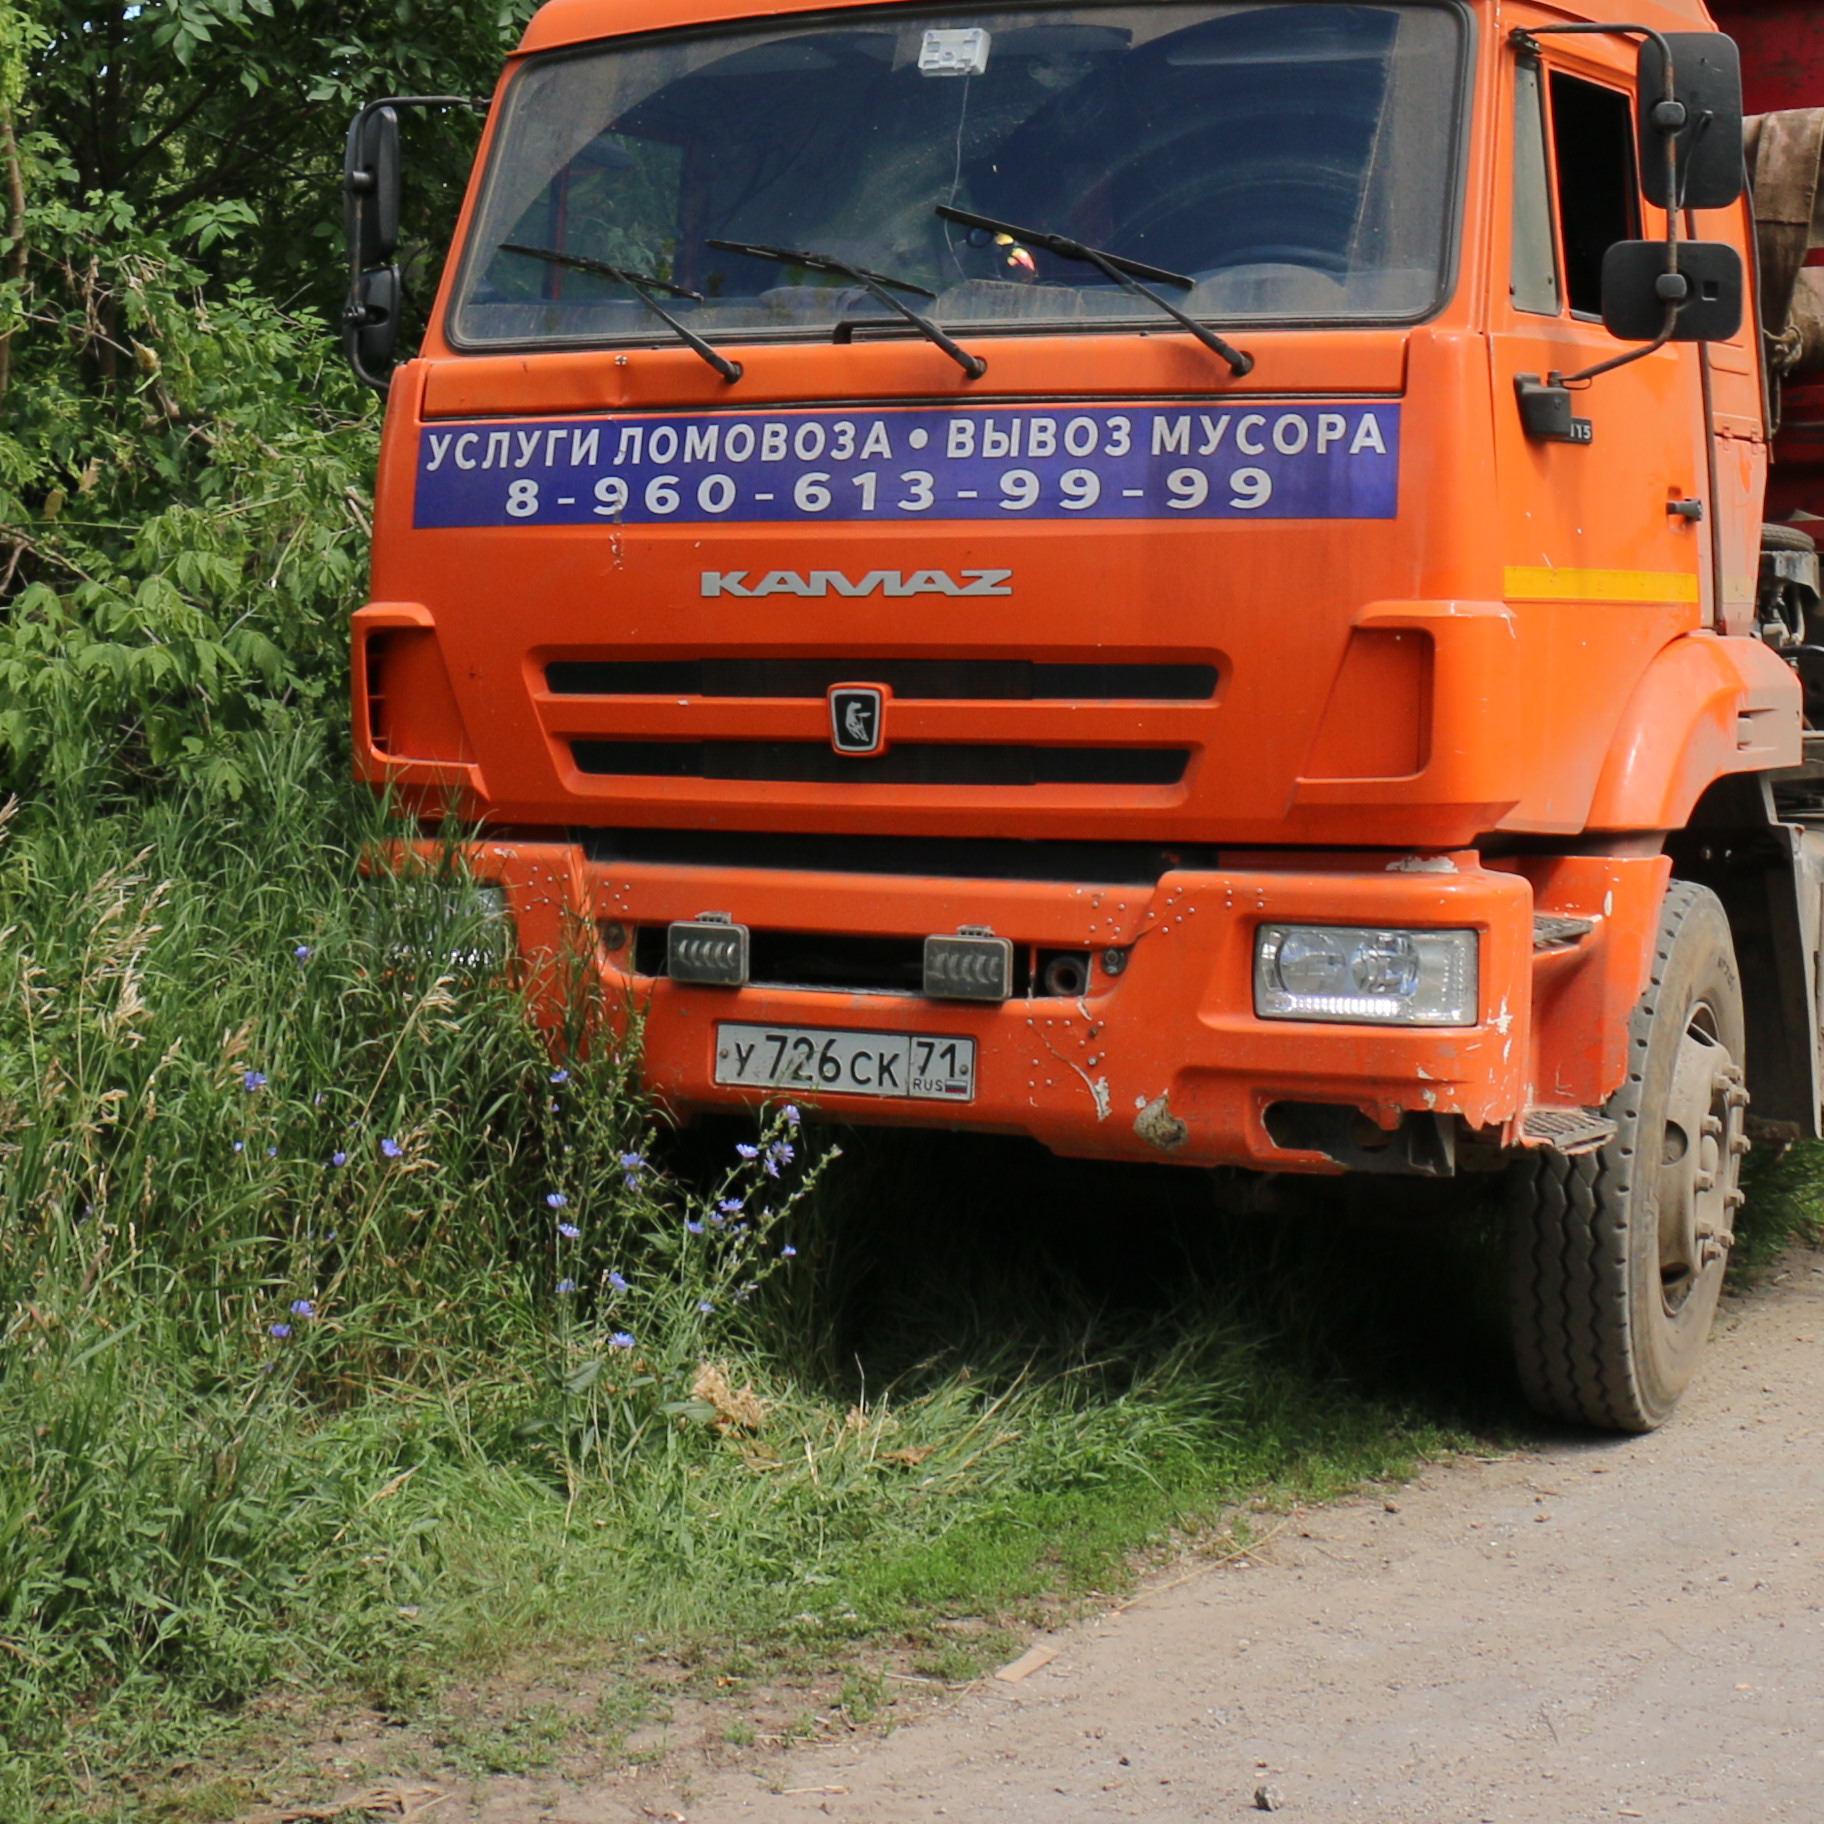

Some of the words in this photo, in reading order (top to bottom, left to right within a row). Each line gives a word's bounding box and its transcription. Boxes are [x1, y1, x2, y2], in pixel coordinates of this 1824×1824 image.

[425, 428, 602, 471] УСЛУГИ
[612, 421, 893, 466] ЛОМОВОЗА
[946, 415, 1132, 459] ВЫВОЗ
[1150, 412, 1387, 457] МУСОРА
[504, 466, 1274, 518] 8-960-613-99-99
[700, 569, 1013, 598] KAMAZ
[916, 1040, 958, 1079] 71
[912, 1078, 944, 1092] RUS
